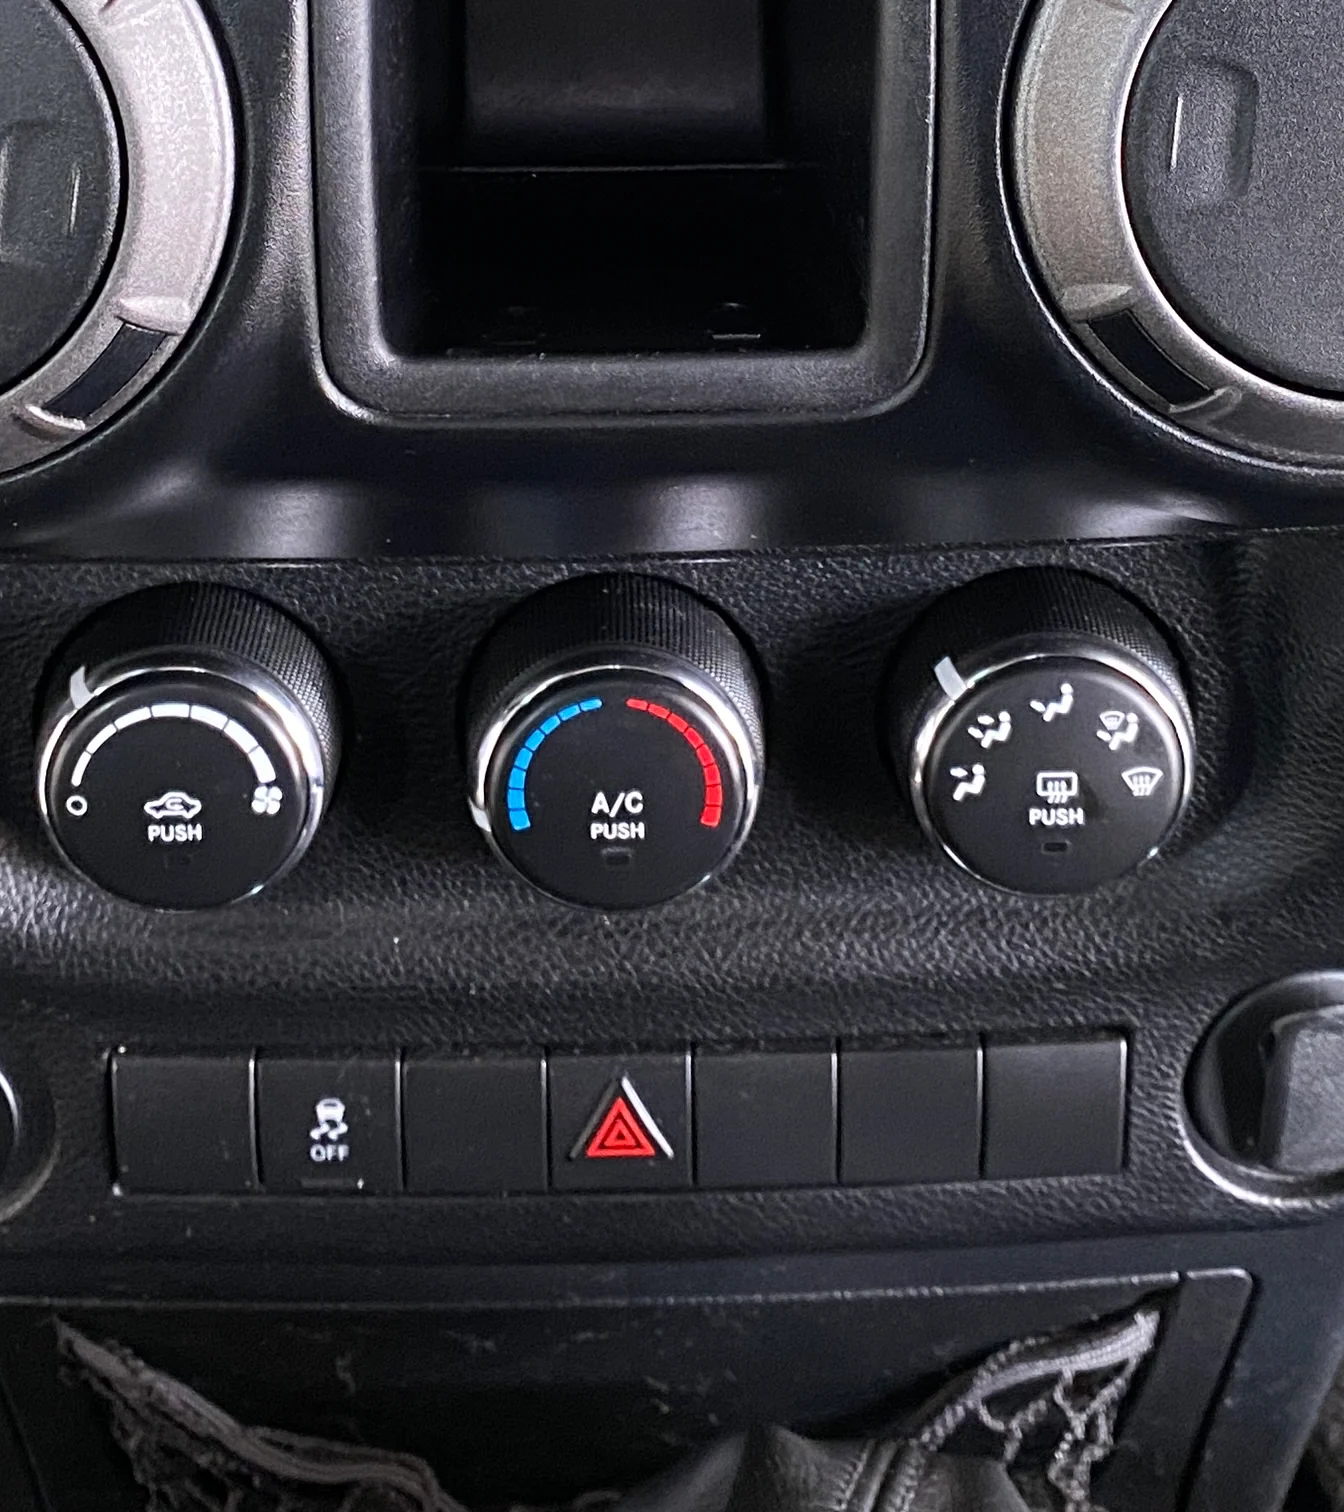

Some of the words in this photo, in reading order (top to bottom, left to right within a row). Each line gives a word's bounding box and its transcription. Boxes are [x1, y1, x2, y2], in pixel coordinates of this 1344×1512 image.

[591, 790, 644, 818] A/C
[1028, 807, 1085, 826] PUSH
[147, 823, 203, 843] PUSH
[590, 821, 646, 841] PUSH
[309, 1143, 350, 1163] OFF
